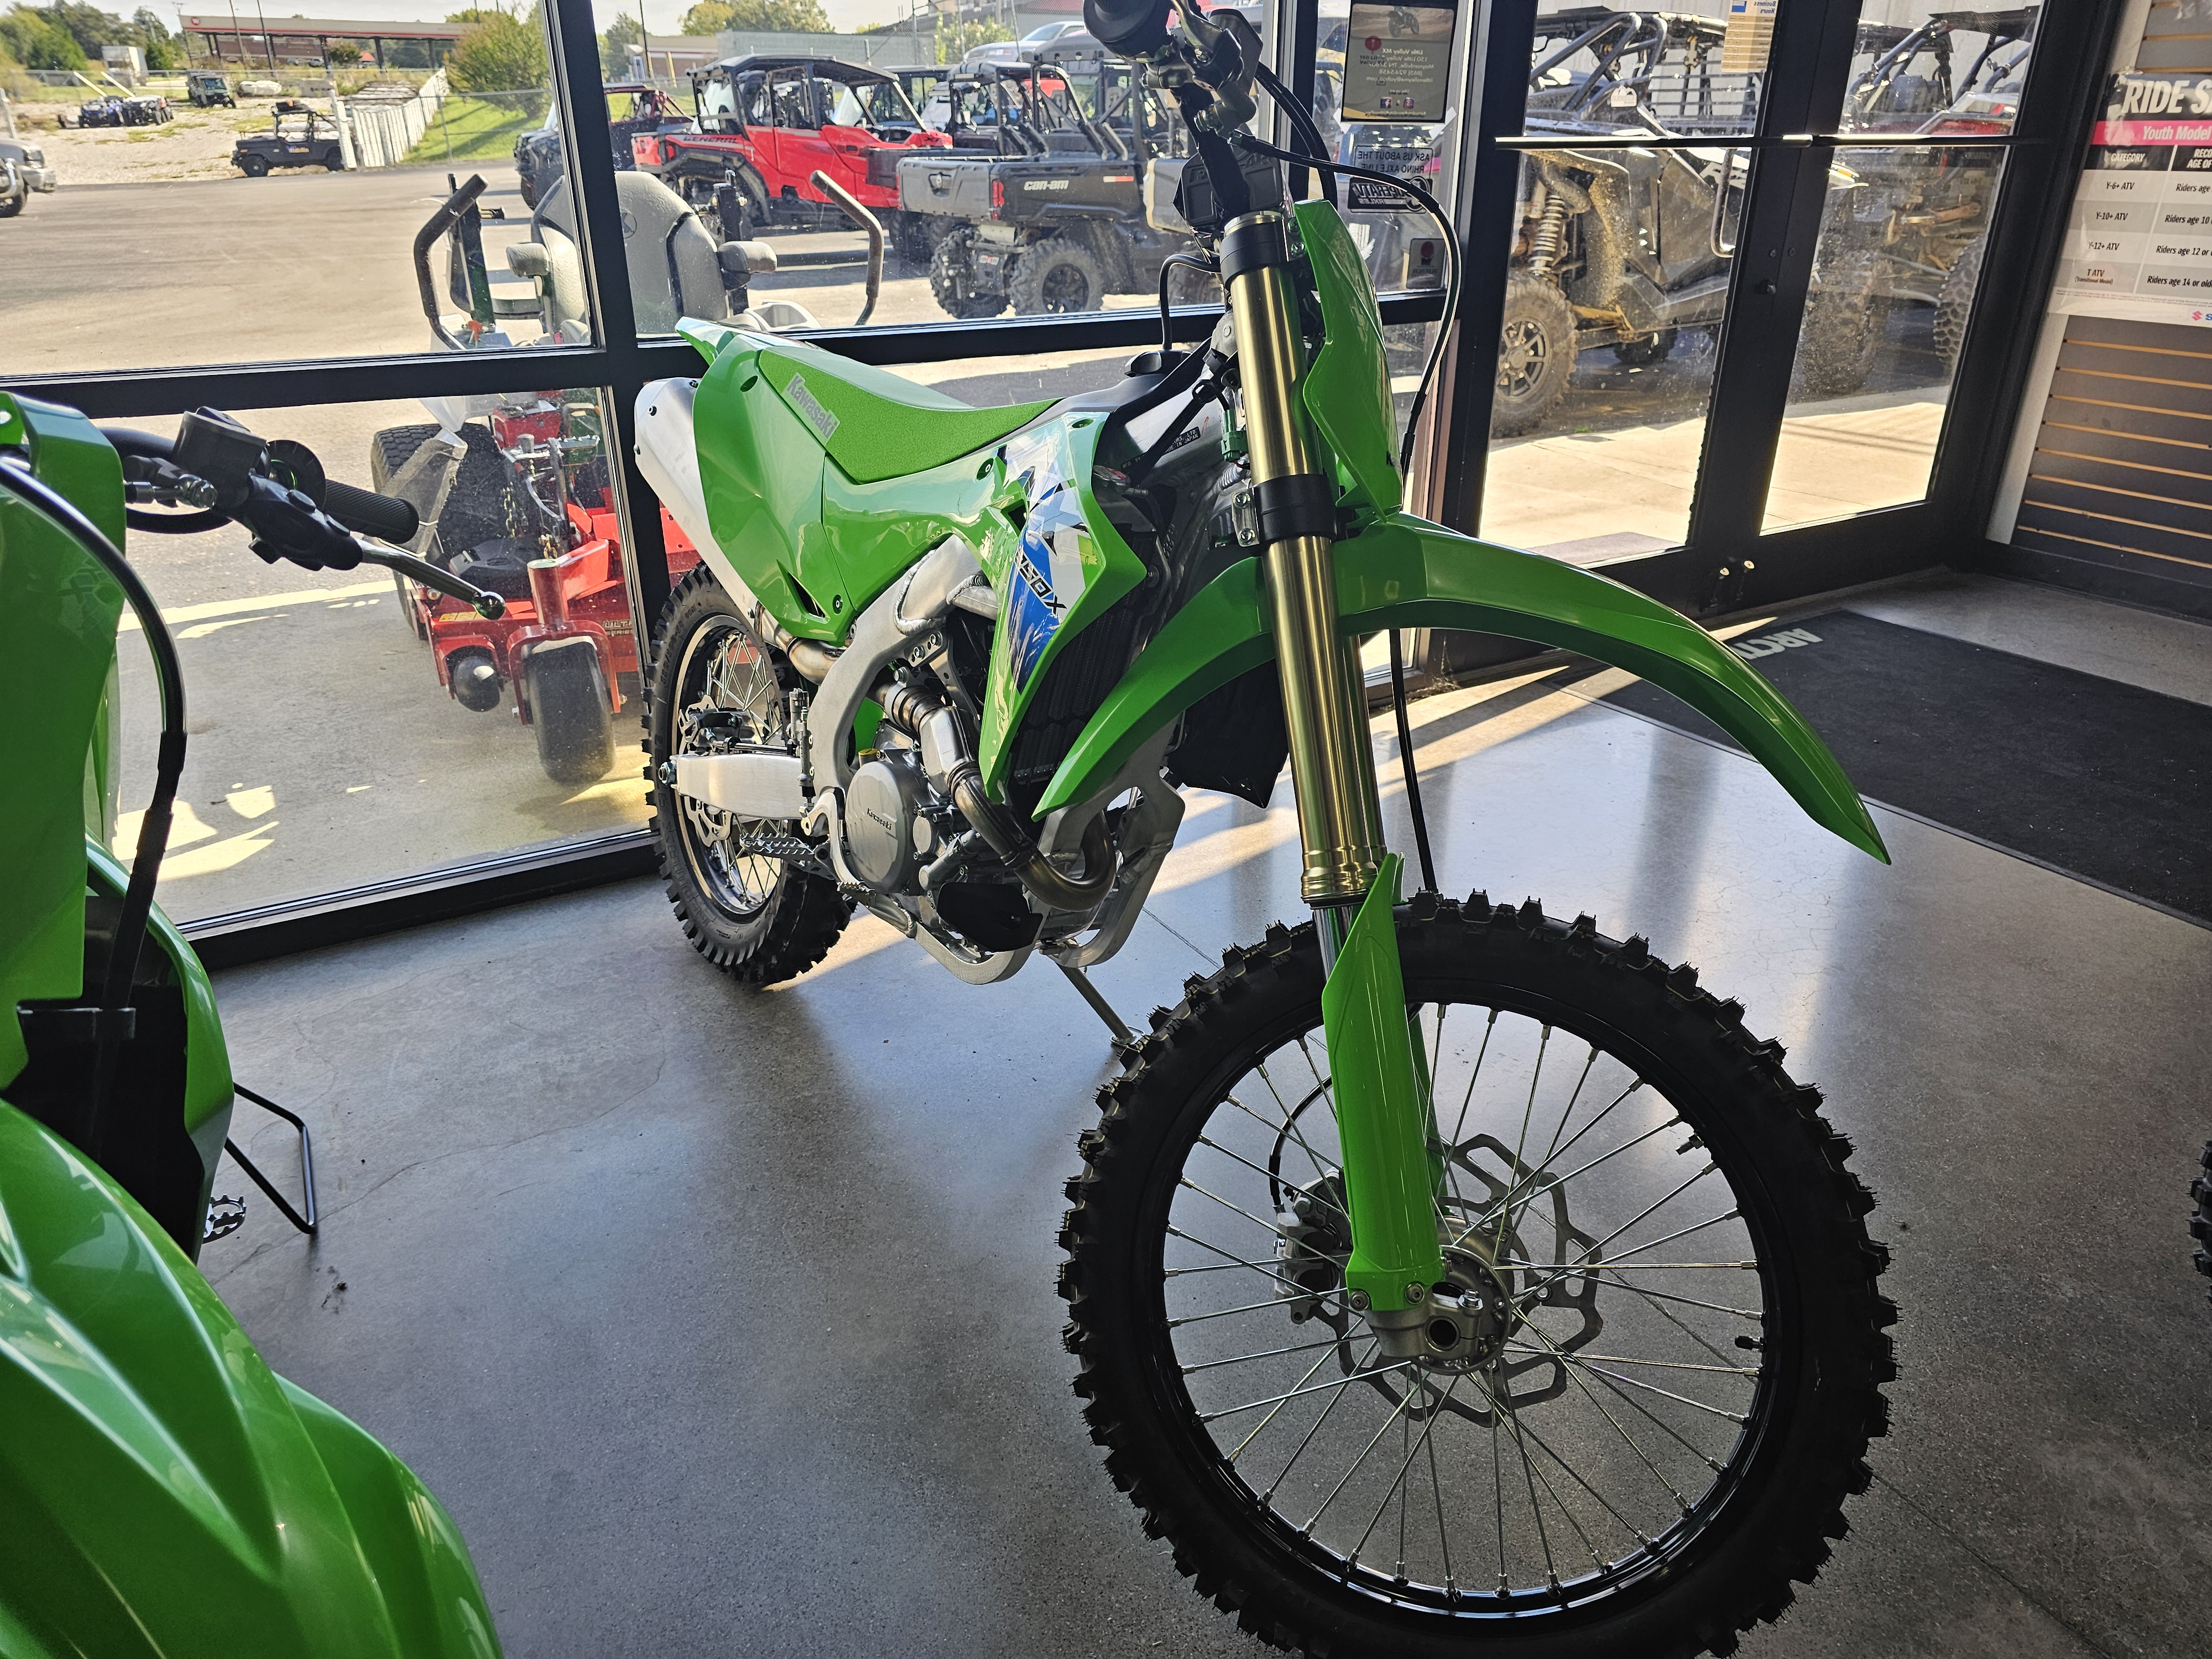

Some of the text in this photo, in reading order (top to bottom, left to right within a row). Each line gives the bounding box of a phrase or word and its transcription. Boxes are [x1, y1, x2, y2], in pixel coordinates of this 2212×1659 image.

[2121, 80, 2190, 113] RIDE
[2142, 126, 2174, 140] Youth
[2110, 153, 2146, 163] CATEGORY
[2186, 159, 2202, 168] AGE
[1024, 180, 1070, 191] can-am
[2106, 181, 2120, 190] Y-6+
[2176, 184, 2211, 194] Riders age
[2096, 211, 2114, 220] Y-10+
[2164, 215, 2185, 223] Riders
[2187, 216, 2199, 226] age
[2088, 242, 2105, 250] Y-12+
[2156, 246, 2176, 254] Riders
[2178, 247, 2190, 256] age
[2147, 276, 2167, 285] Riders
[2168, 278, 2181, 286] age
[2182, 278, 2190, 286] 14
[786, 375, 838, 440] Kawasaki
[1187, 429, 1198, 437] LTD.
[1185, 434, 1198, 444] JAPAN
[867, 807, 892, 836] Kawasaki
